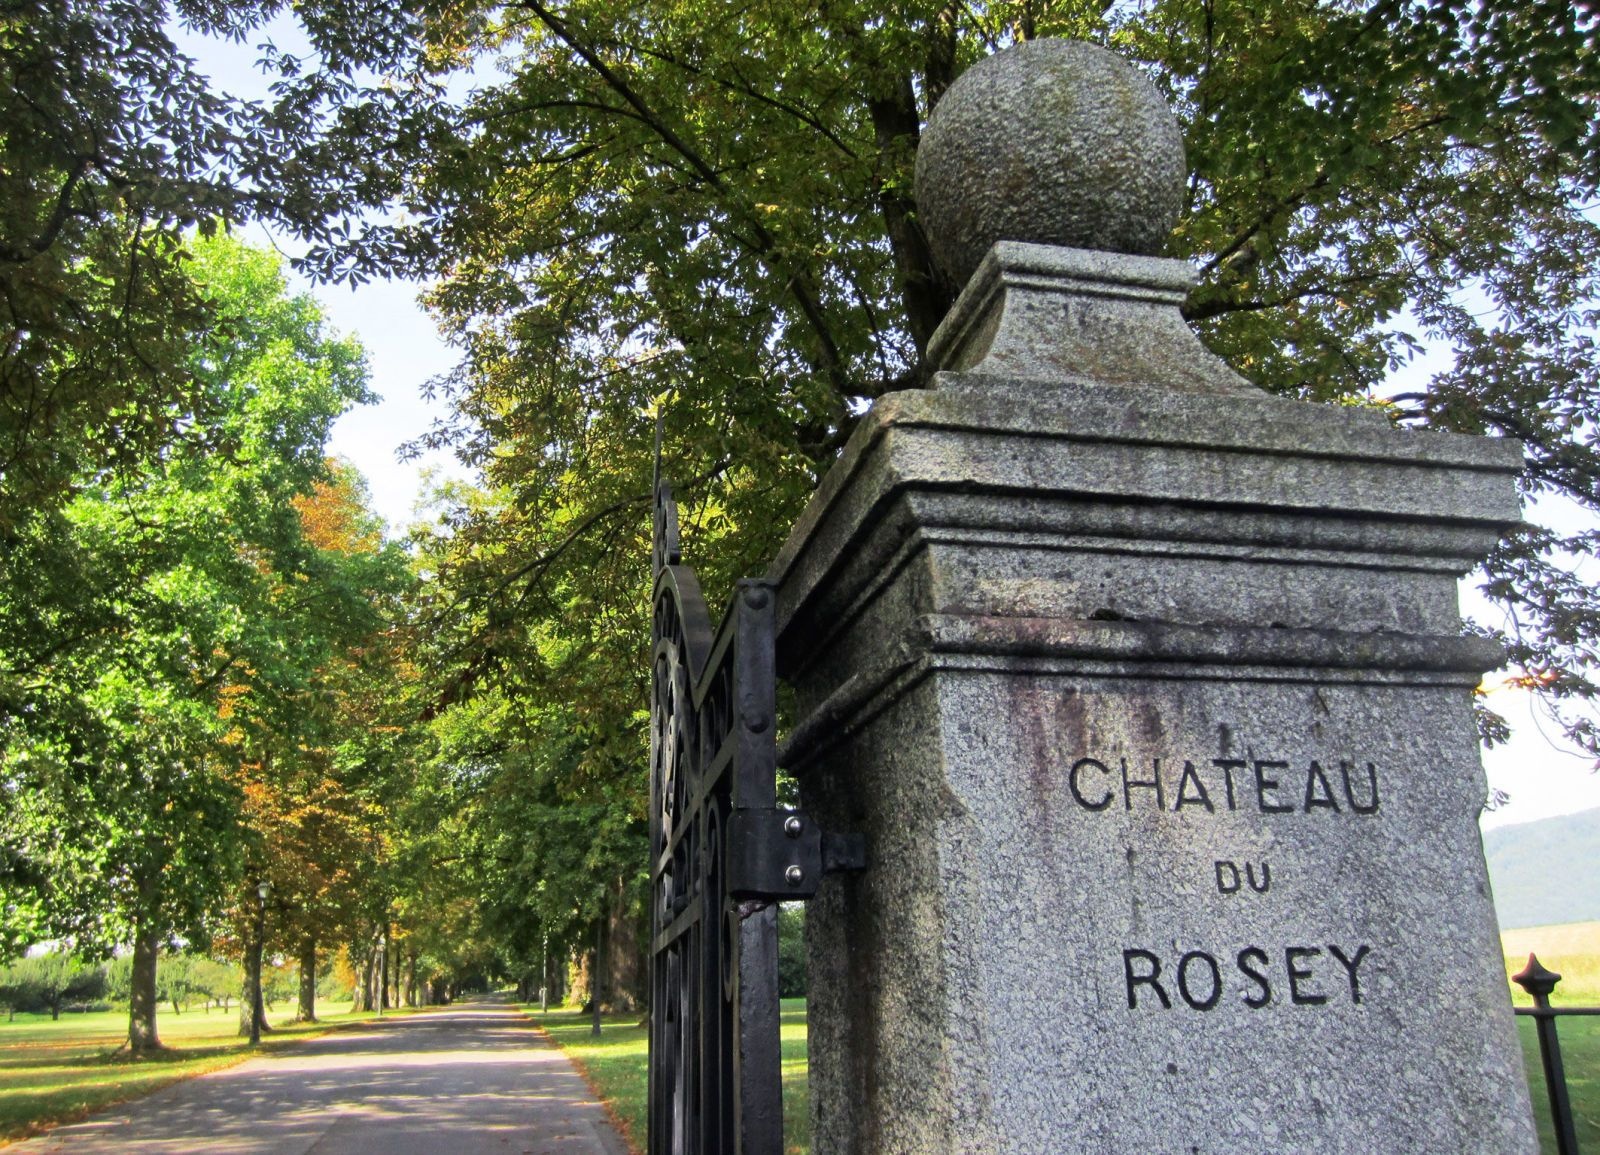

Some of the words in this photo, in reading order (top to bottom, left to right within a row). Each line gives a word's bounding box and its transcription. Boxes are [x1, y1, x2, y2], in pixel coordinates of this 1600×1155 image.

[1069, 757, 1380, 815] CHATEAU
[1214, 861, 1271, 894] DU
[1123, 945, 1371, 1011] ROSEY
